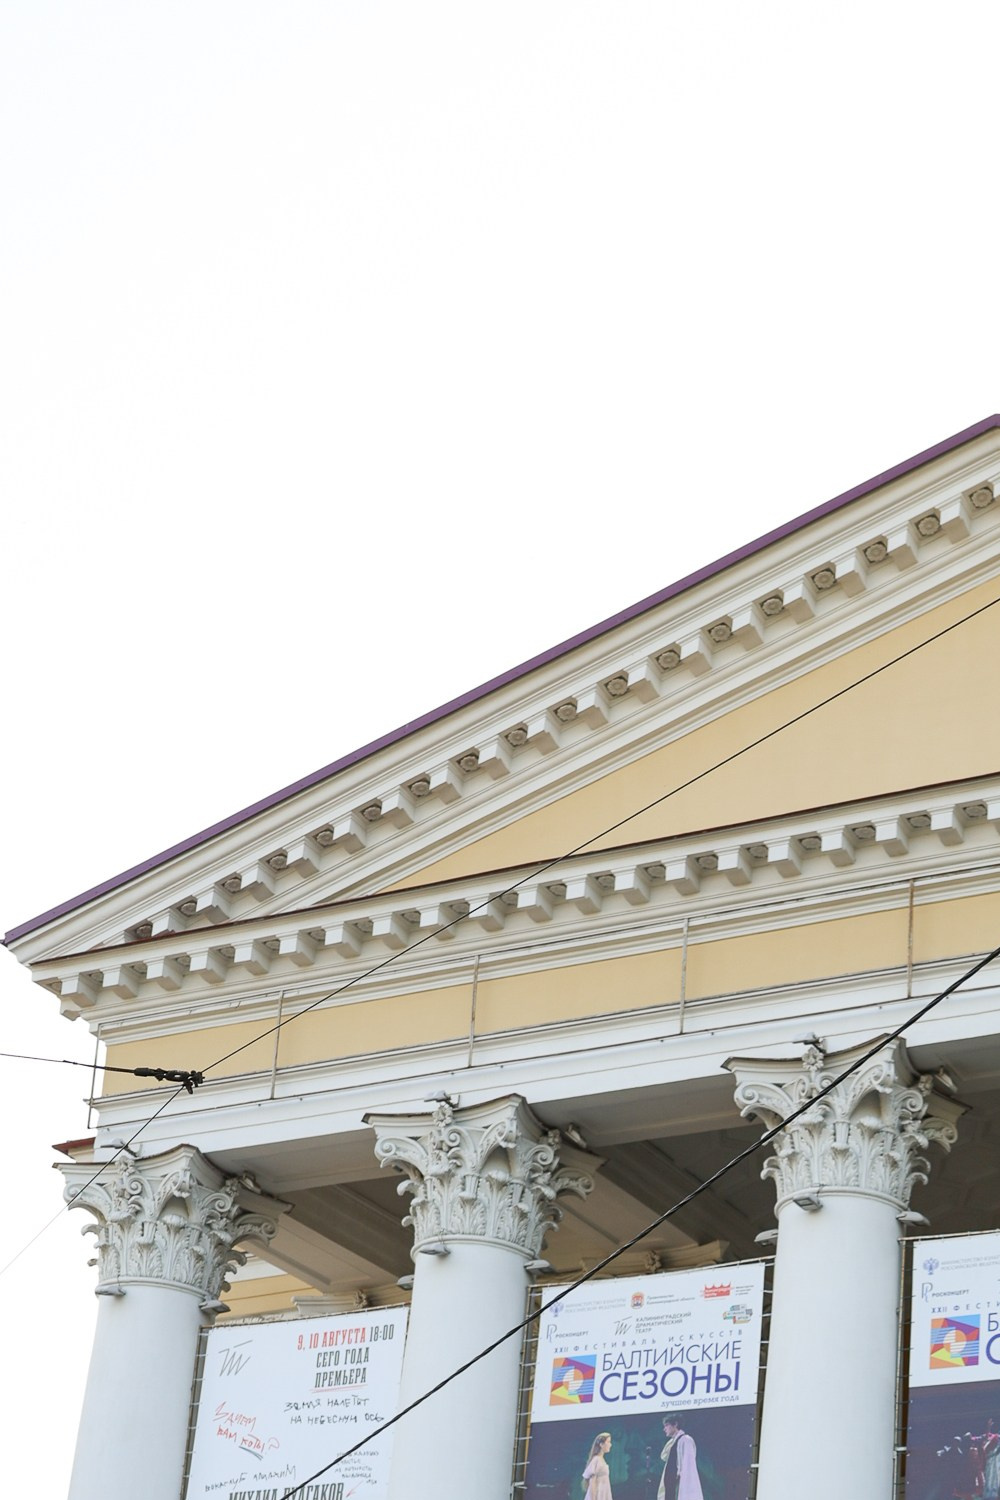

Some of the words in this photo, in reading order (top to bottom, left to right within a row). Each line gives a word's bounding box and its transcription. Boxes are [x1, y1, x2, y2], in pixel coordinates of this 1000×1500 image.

[932, 1290, 969, 1298] РОСКОНЦЕРТ
[310, 1334, 318, 1348] 10
[322, 1328, 366, 1347] АВГУСТА
[370, 1324, 394, 1342] 18:00
[573, 1339, 657, 1352] ФЕСТИВАЛЬ
[669, 1330, 743, 1342] ИСКУССТВ
[316, 1350, 339, 1368] СЕГО
[344, 1347, 369, 1364] ГОДА
[603, 1341, 741, 1371] БАЛТИЙСКИЕ
[315, 1368, 367, 1388] ПРЕМЬЕРА
[600, 1361, 740, 1402] СЕЗОНЫ
[661, 1399, 692, 1408] лучшее
[694, 1396, 719, 1406] время
[721, 1395, 739, 1403] года
